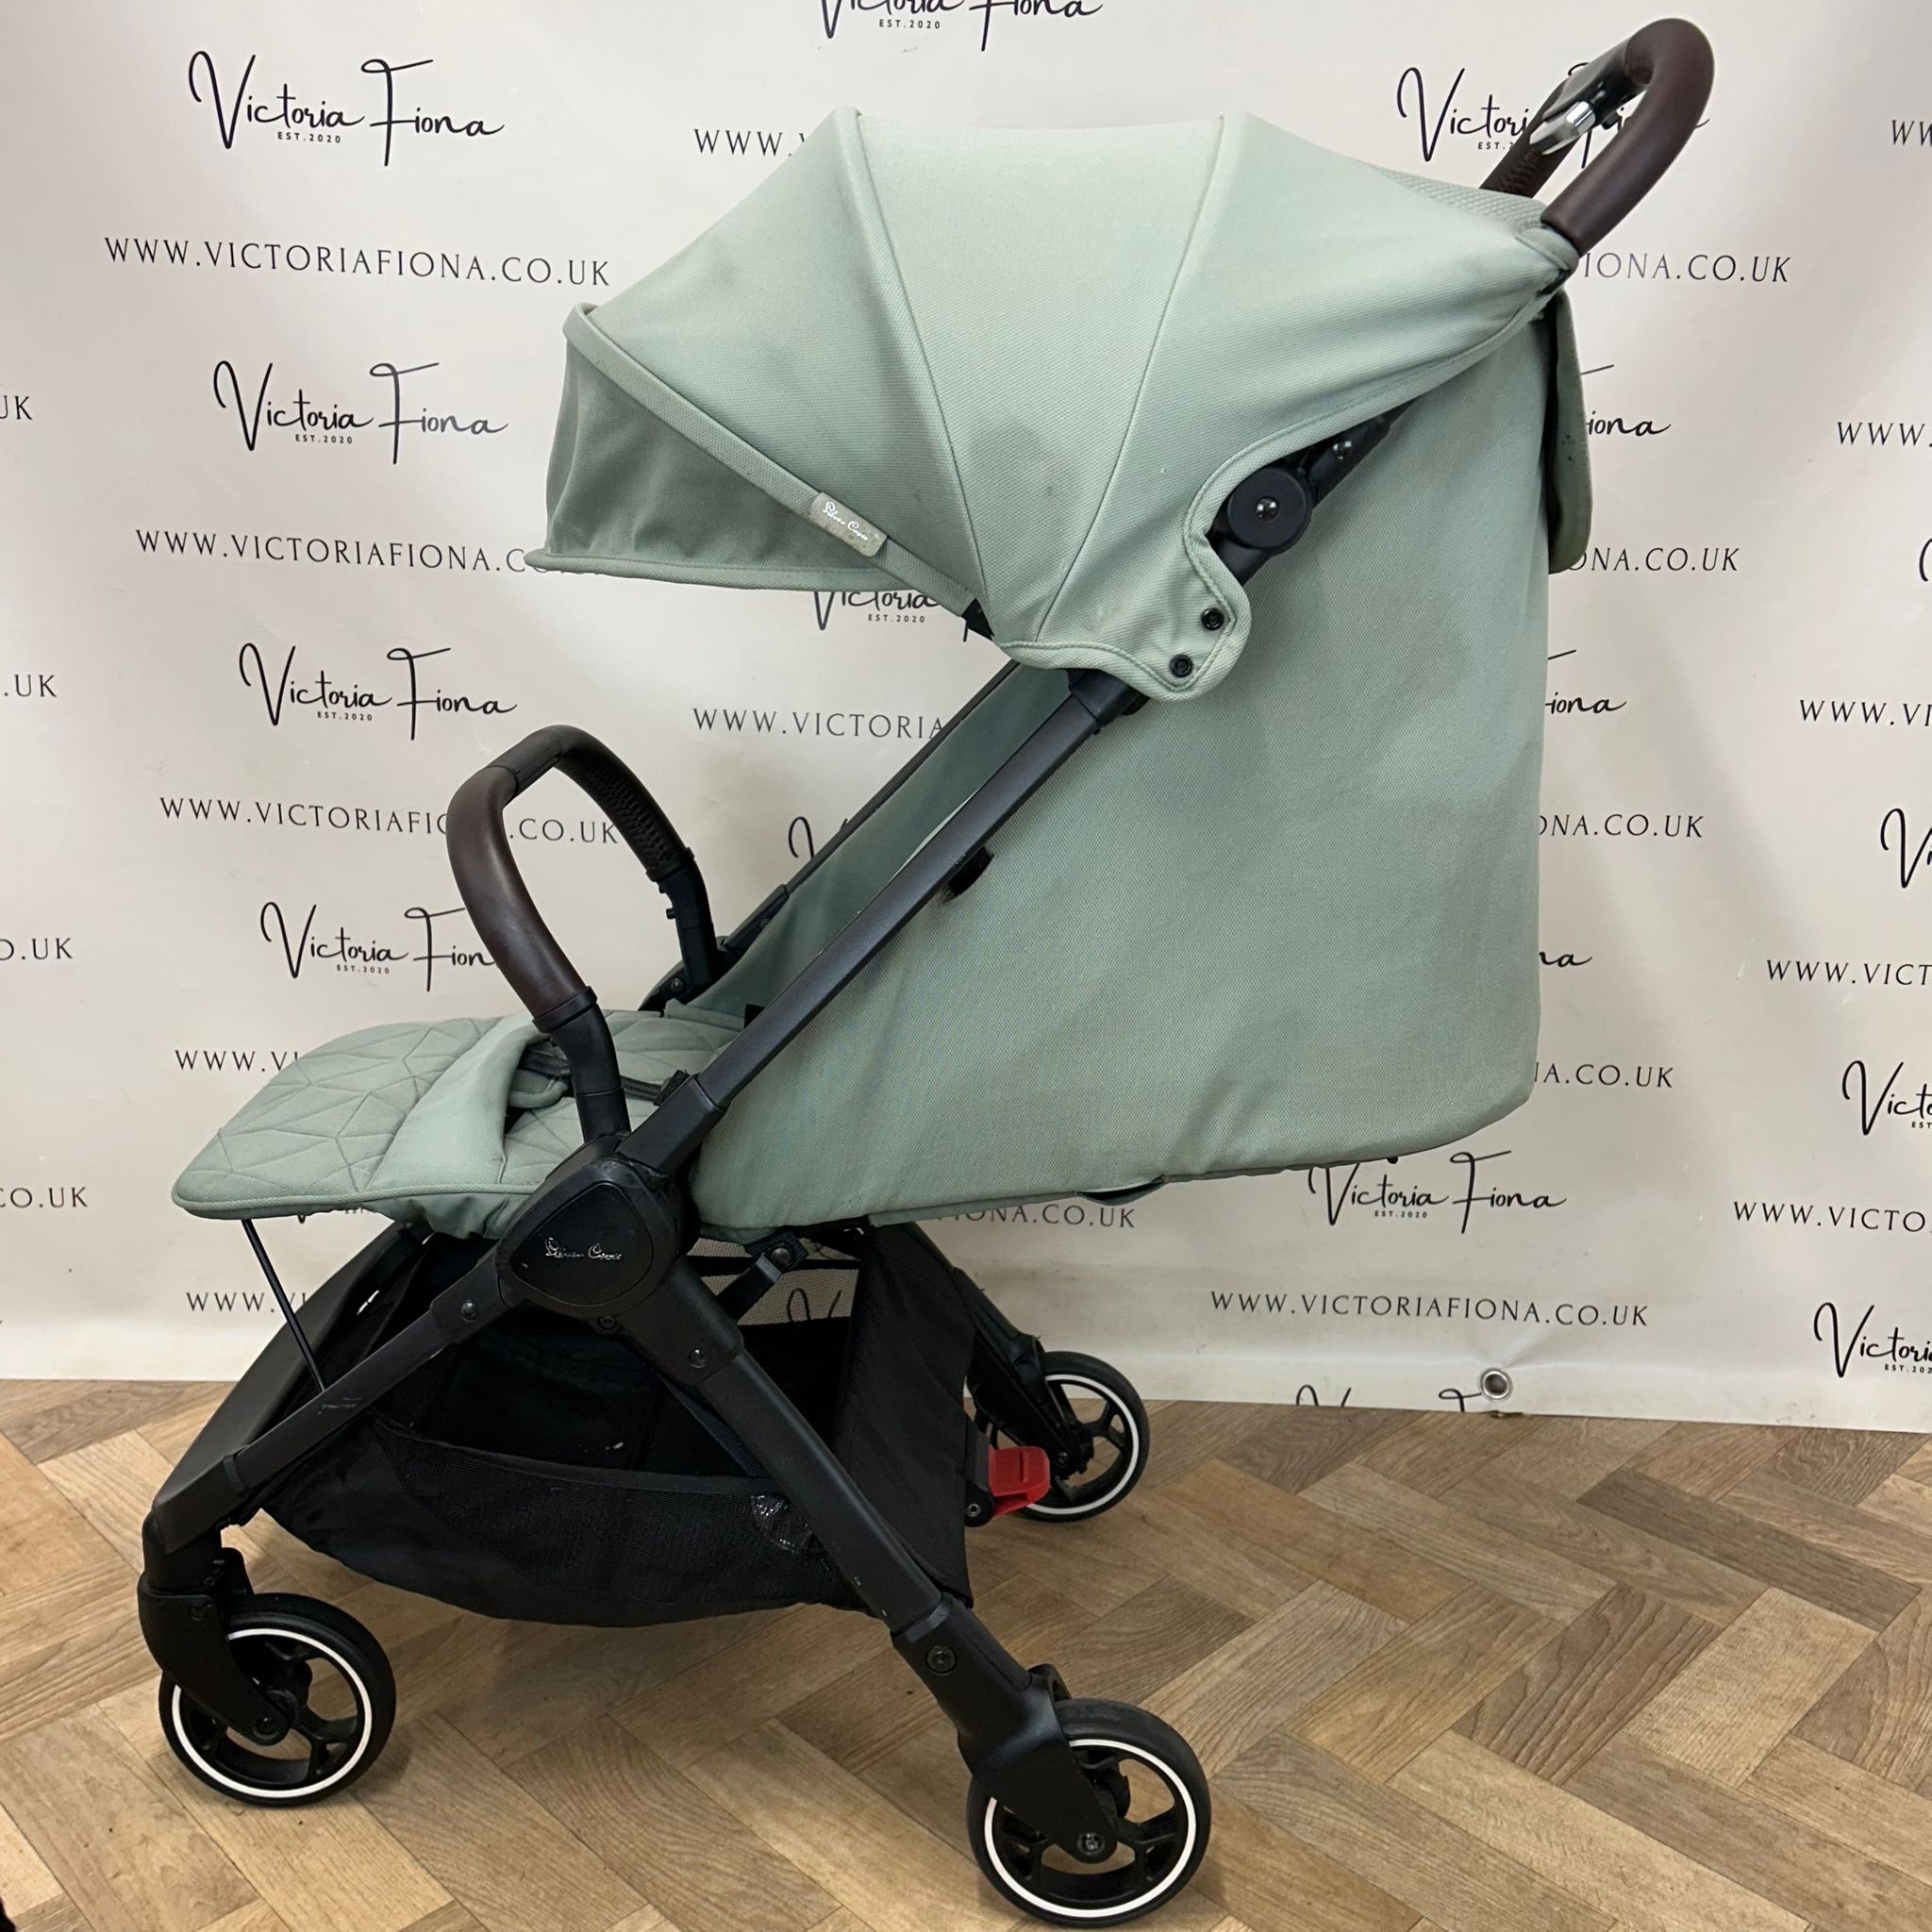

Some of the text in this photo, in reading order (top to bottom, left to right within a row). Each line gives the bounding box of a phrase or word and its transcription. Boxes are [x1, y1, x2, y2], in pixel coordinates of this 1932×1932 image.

[878, 19, 941, 29] EST.2020
[189, 51, 505, 167] Victoria Fiona
[1397, 67, 1529, 162] Victori
[277, 131, 341, 143] EST.2020
[105, 237, 610, 286] WWW.VICTORIAFIONA.CO.UK
[213, 360, 509, 465] Victoria Fiona
[294, 434, 353, 444] EST.2020
[135, 529, 547, 574] WWW.VICTORIAFIONA.C
[867, 613, 925, 623] EST.2020
[239, 642, 518, 741] Victoria Fiona
[317, 710, 373, 721] EST.2020
[260, 902, 495, 993] Victoria Fion
[336, 964, 390, 974] EST.2020
[1307, 1150, 1568, 1234] Victoria Fiona
[1374, 1210, 1428, 1219] EST.2020
[1733, 1201, 1932, 1233] WWW.VICTO
[1210, 1291, 1648, 1326] WWW.VICTORIAFIONA.CO.UK
[1813, 1302, 1932, 1378] Victori
